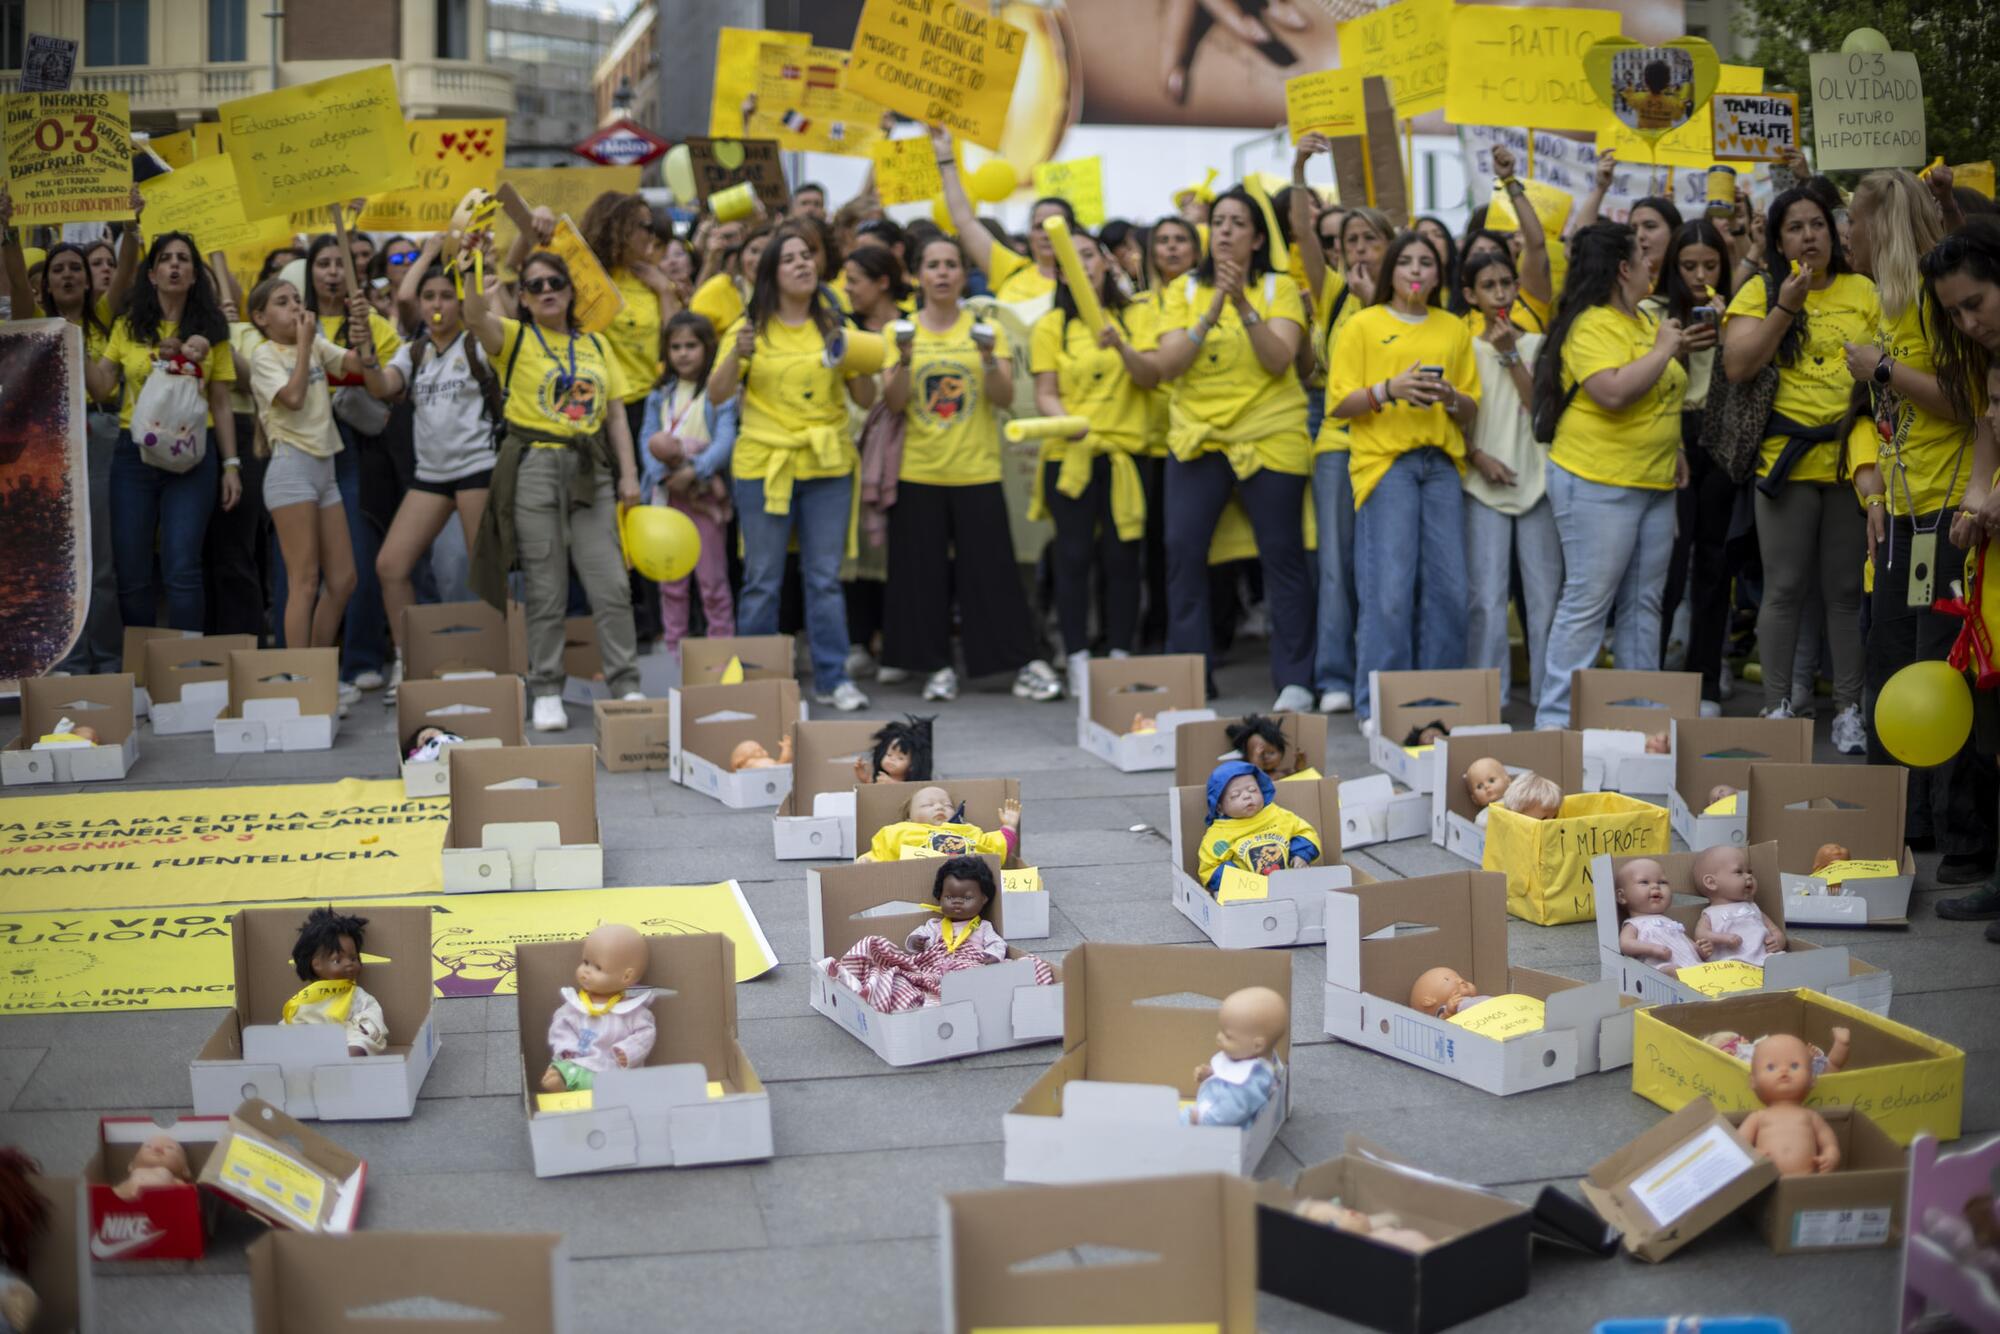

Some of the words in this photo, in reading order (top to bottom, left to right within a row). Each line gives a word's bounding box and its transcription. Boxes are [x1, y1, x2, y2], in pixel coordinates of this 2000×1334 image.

[1392, 8, 1417, 39] ES
[919, 20, 984, 64] INFANCIA
[997, 26, 1020, 54] DE
[1848, 53, 1886, 76] 0-3
[1819, 77, 1918, 101] OLVIDADO
[40, 94, 109, 108] INFORMES
[1838, 110, 1894, 125] FUTURO
[34, 114, 99, 154] 0-3
[1821, 129, 1921, 148] HIPOTECADO
[605, 140, 648, 154] Metro
[35, 819, 73, 831] ES
[81, 818, 121, 828] LA
[220, 814, 260, 822] DE
[269, 811, 310, 821] LA
[193, 823, 235, 833] EN
[1603, 827, 1653, 854] PROFE
[0, 861, 141, 876] NFANTIL
[152, 849, 399, 869] FUENTELUCHA
[1238, 877, 1260, 892] NO
[51, 919, 83, 930] Y
[0, 926, 230, 945] UCIONA
[101, 983, 235, 996] INFANCI
[0, 997, 150, 1010] UCACIÓN
[102, 1214, 151, 1241] NIKE
